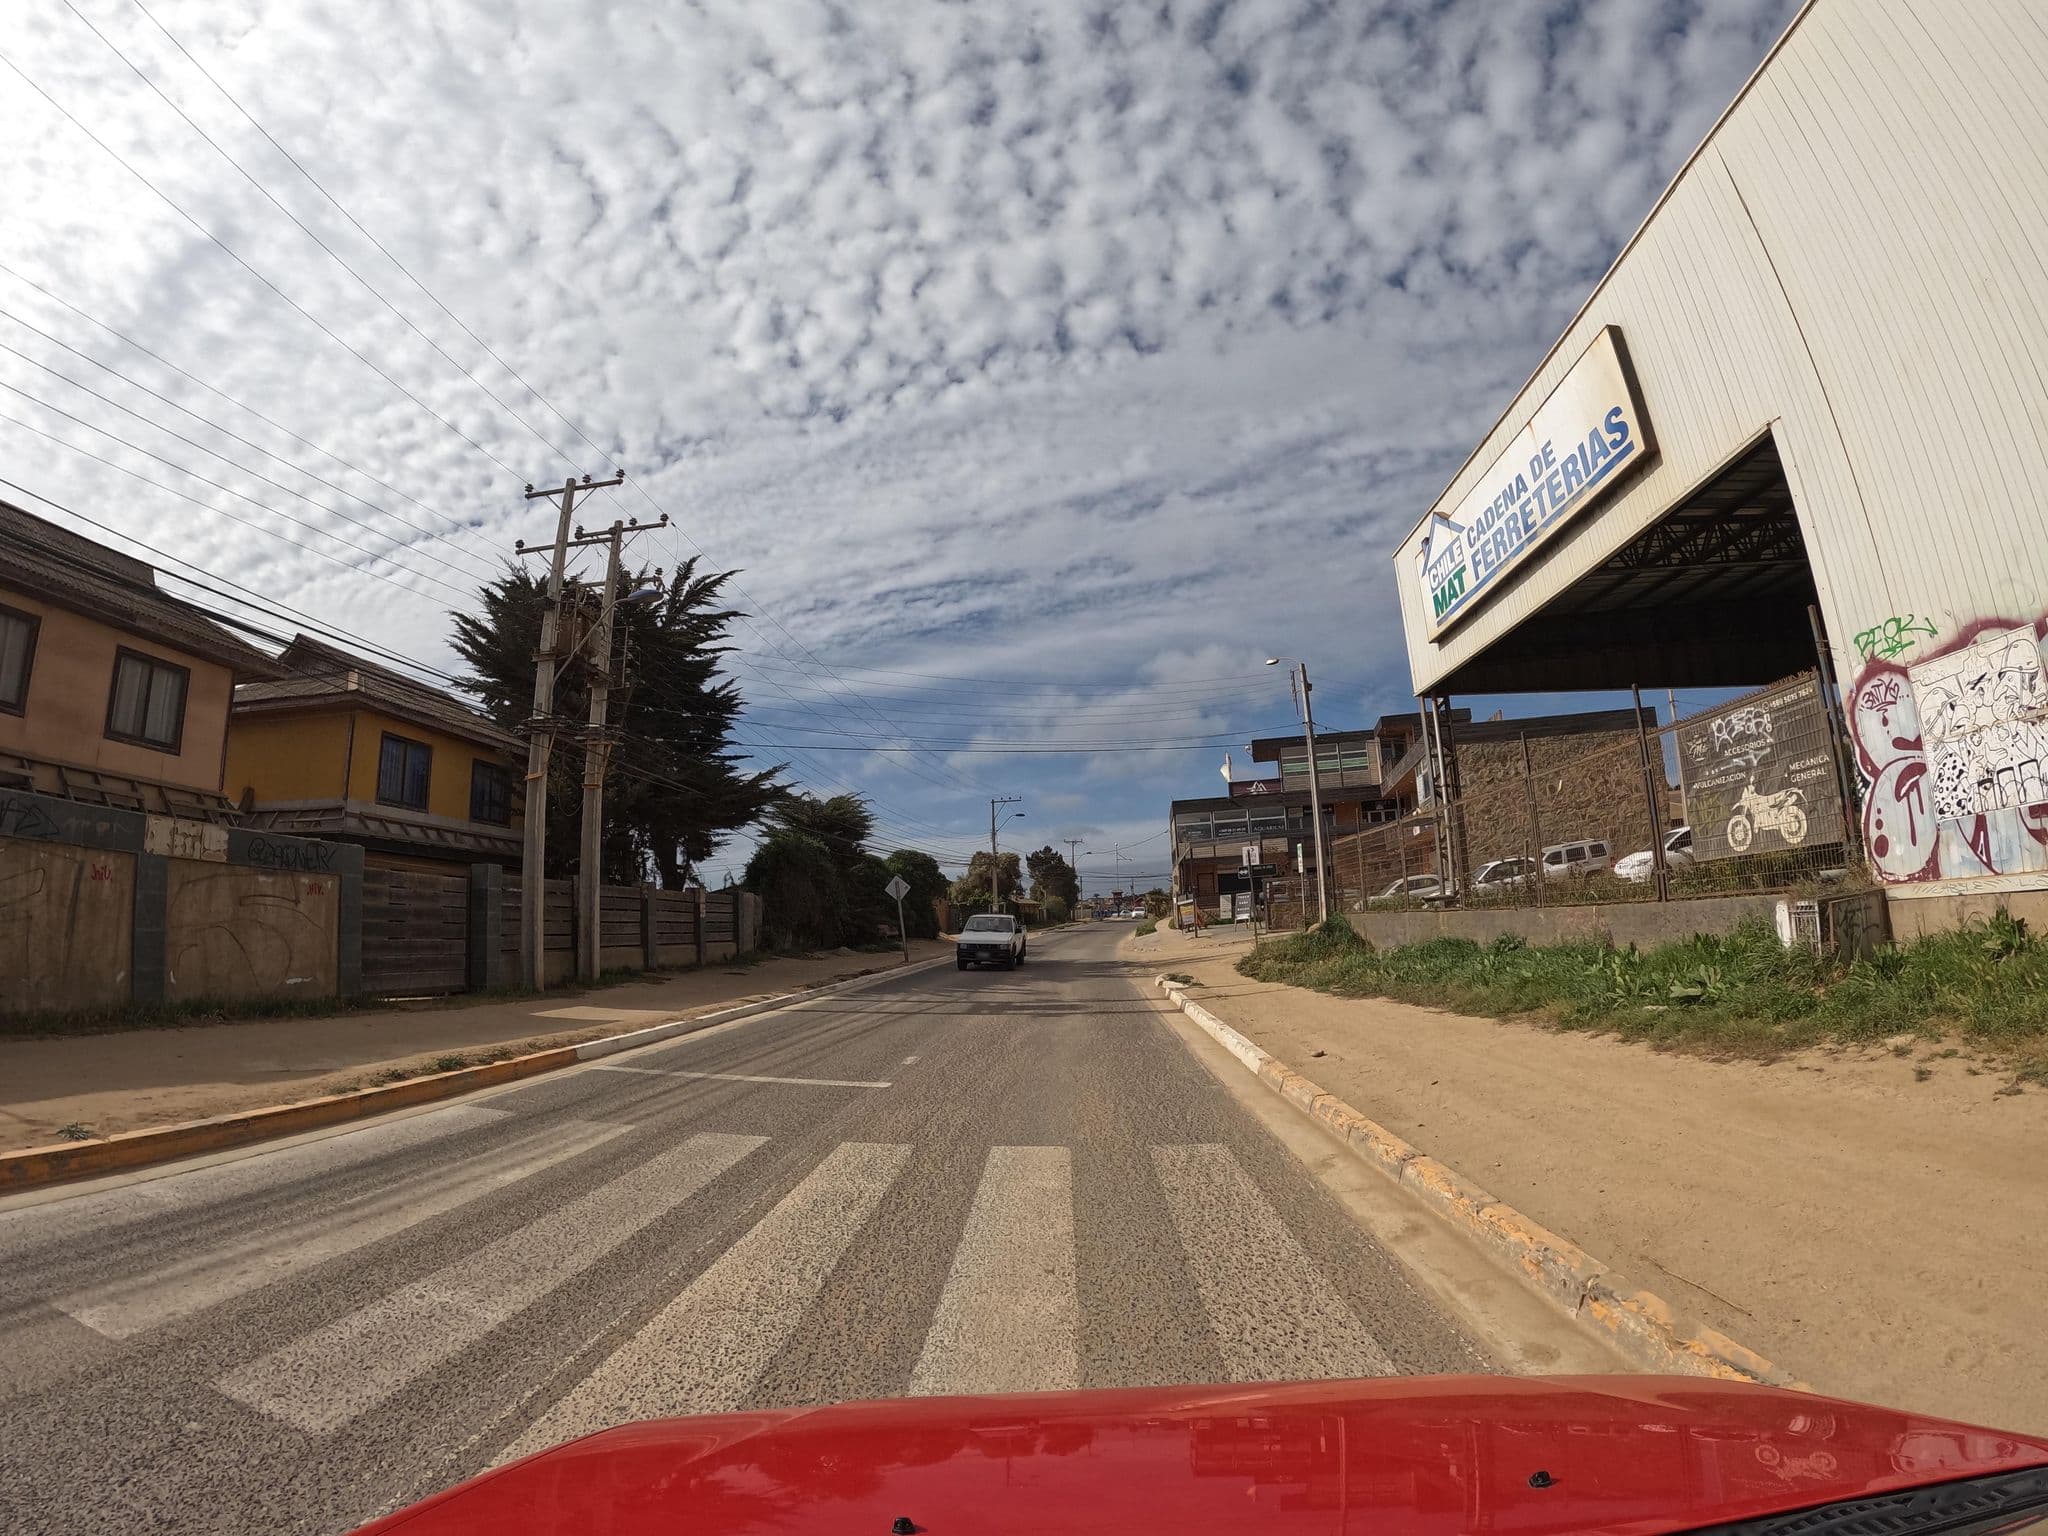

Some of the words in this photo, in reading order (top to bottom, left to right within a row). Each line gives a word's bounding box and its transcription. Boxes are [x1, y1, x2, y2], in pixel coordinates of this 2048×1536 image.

[1467, 473, 1528, 549] CADENA
[1529, 440, 1556, 482] DE
[1471, 406, 1629, 580] FERRETERIAS
[1429, 536, 1464, 590] CHILE
[1433, 564, 1466, 618] MAT
[1724, 739, 1766, 756] ACCESORIOS
[1791, 767, 1827, 782] GENERAL
